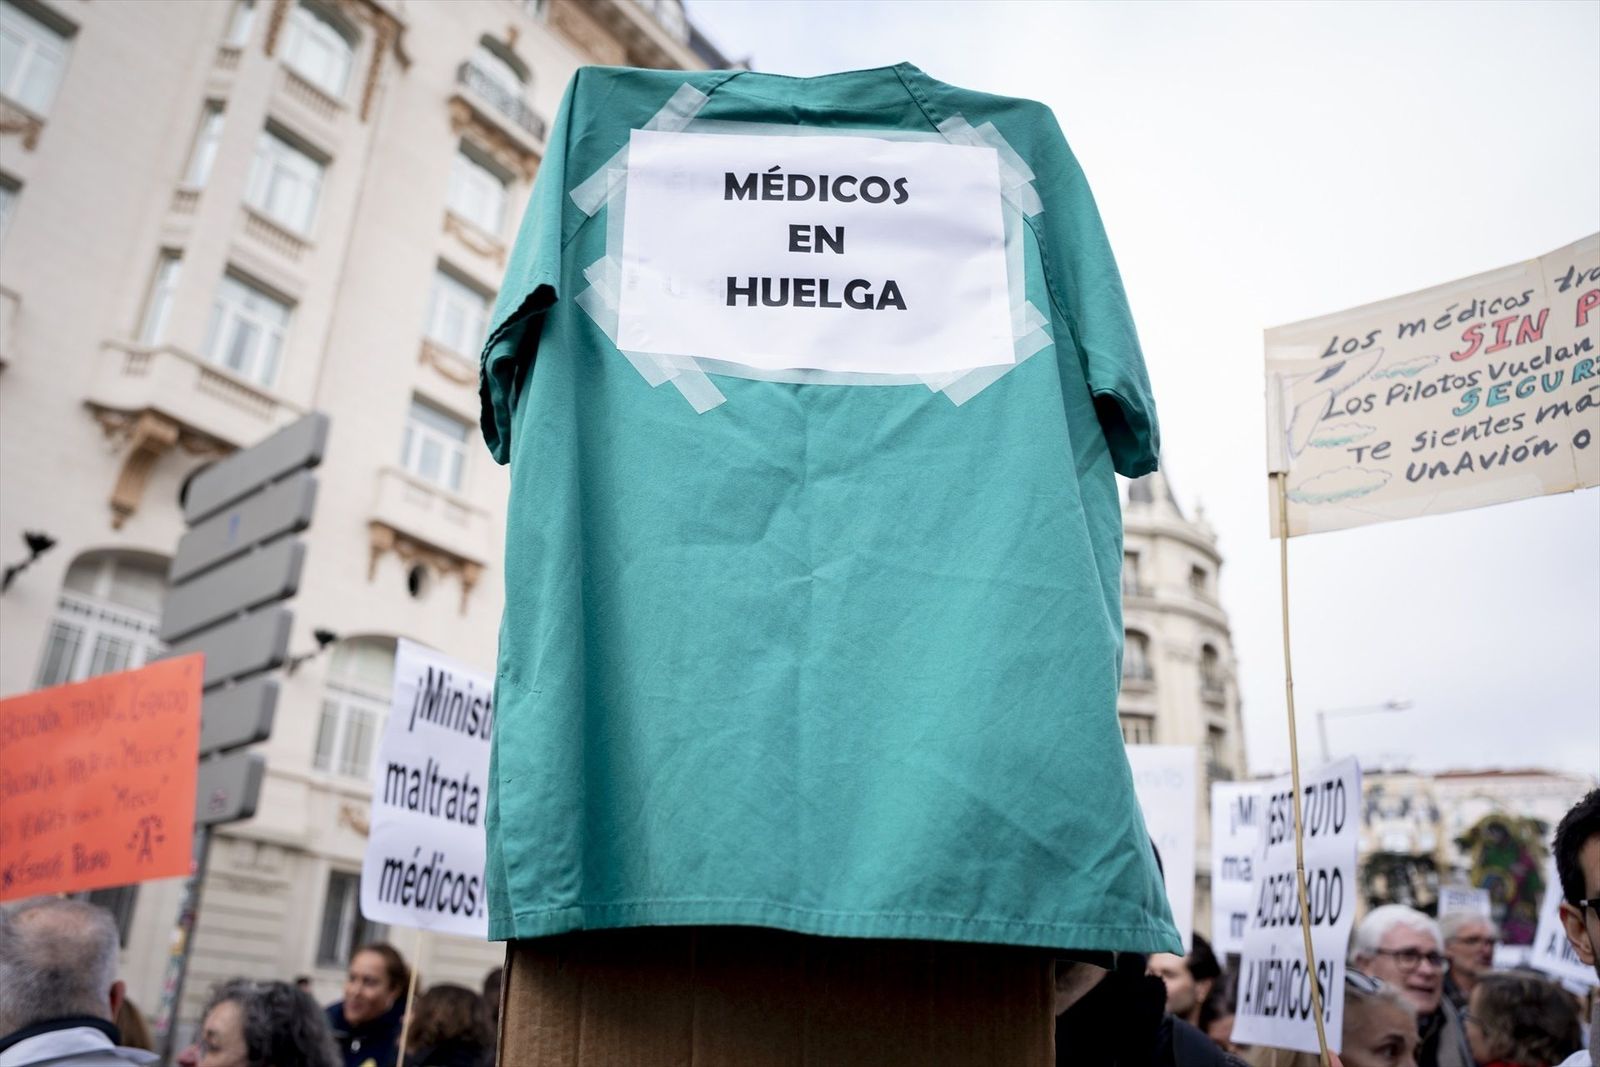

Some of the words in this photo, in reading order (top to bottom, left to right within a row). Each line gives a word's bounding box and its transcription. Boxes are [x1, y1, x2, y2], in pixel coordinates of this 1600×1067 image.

[723, 164, 909, 205] MÉDICOS
[788, 224, 845, 255] EN
[725, 276, 908, 311] HUELGA
[1398, 289, 1535, 339] médicos
[1450, 307, 1550, 362] SIN
[383, 757, 481, 826] maltrata
[377, 845, 486, 918] médicos!
